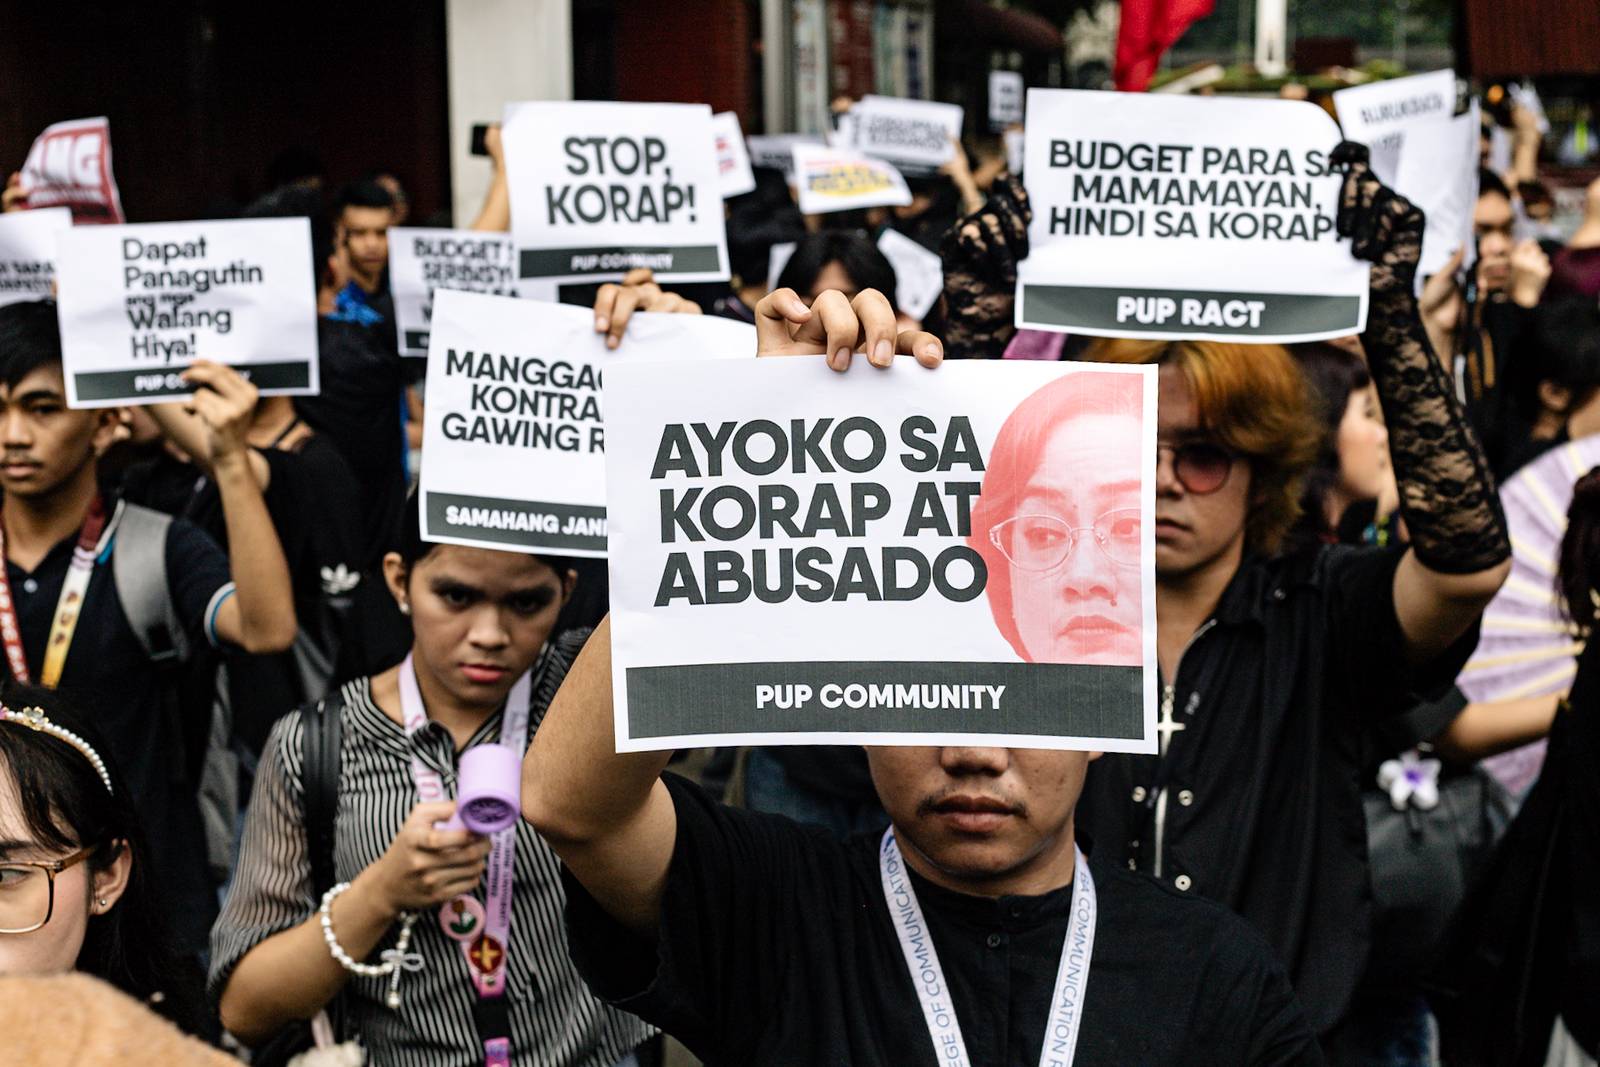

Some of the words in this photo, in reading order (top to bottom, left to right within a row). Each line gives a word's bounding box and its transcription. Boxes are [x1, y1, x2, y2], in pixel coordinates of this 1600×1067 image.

[564, 136, 671, 181] STOP,
[1050, 139, 1193, 173] BUDGET
[1202, 146, 1295, 176] PARA
[545, 184, 697, 225] KORAP!
[1072, 174, 1321, 212] MAMAMAYAN,
[1050, 207, 1144, 237] HINDI
[1154, 210, 1199, 238] SA
[122, 235, 206, 265] Dapat
[413, 238, 502, 259] BUDGET
[124, 259, 264, 292] Panagutin
[127, 304, 232, 334] Walang
[1117, 296, 1176, 324] PUP
[1181, 298, 1265, 328] RACT
[131, 333, 197, 365] Hiya!
[446, 348, 603, 391] MANGGA
[441, 412, 580, 452] GAWING
[650, 416, 886, 479] AYOKO
[900, 415, 985, 472] SA
[446, 504, 560, 534] SAMAHANG
[660, 482, 891, 543] KORAP
[903, 481, 981, 537] AT
[654, 545, 988, 607] ABUSADO
[756, 684, 812, 710] PUP
[820, 683, 1006, 710] COMMUNITY
[886, 848, 942, 996] COMMUNICATION
[1051, 897, 1090, 1055] COMMUNICATION
[930, 1003, 951, 1028] OF
